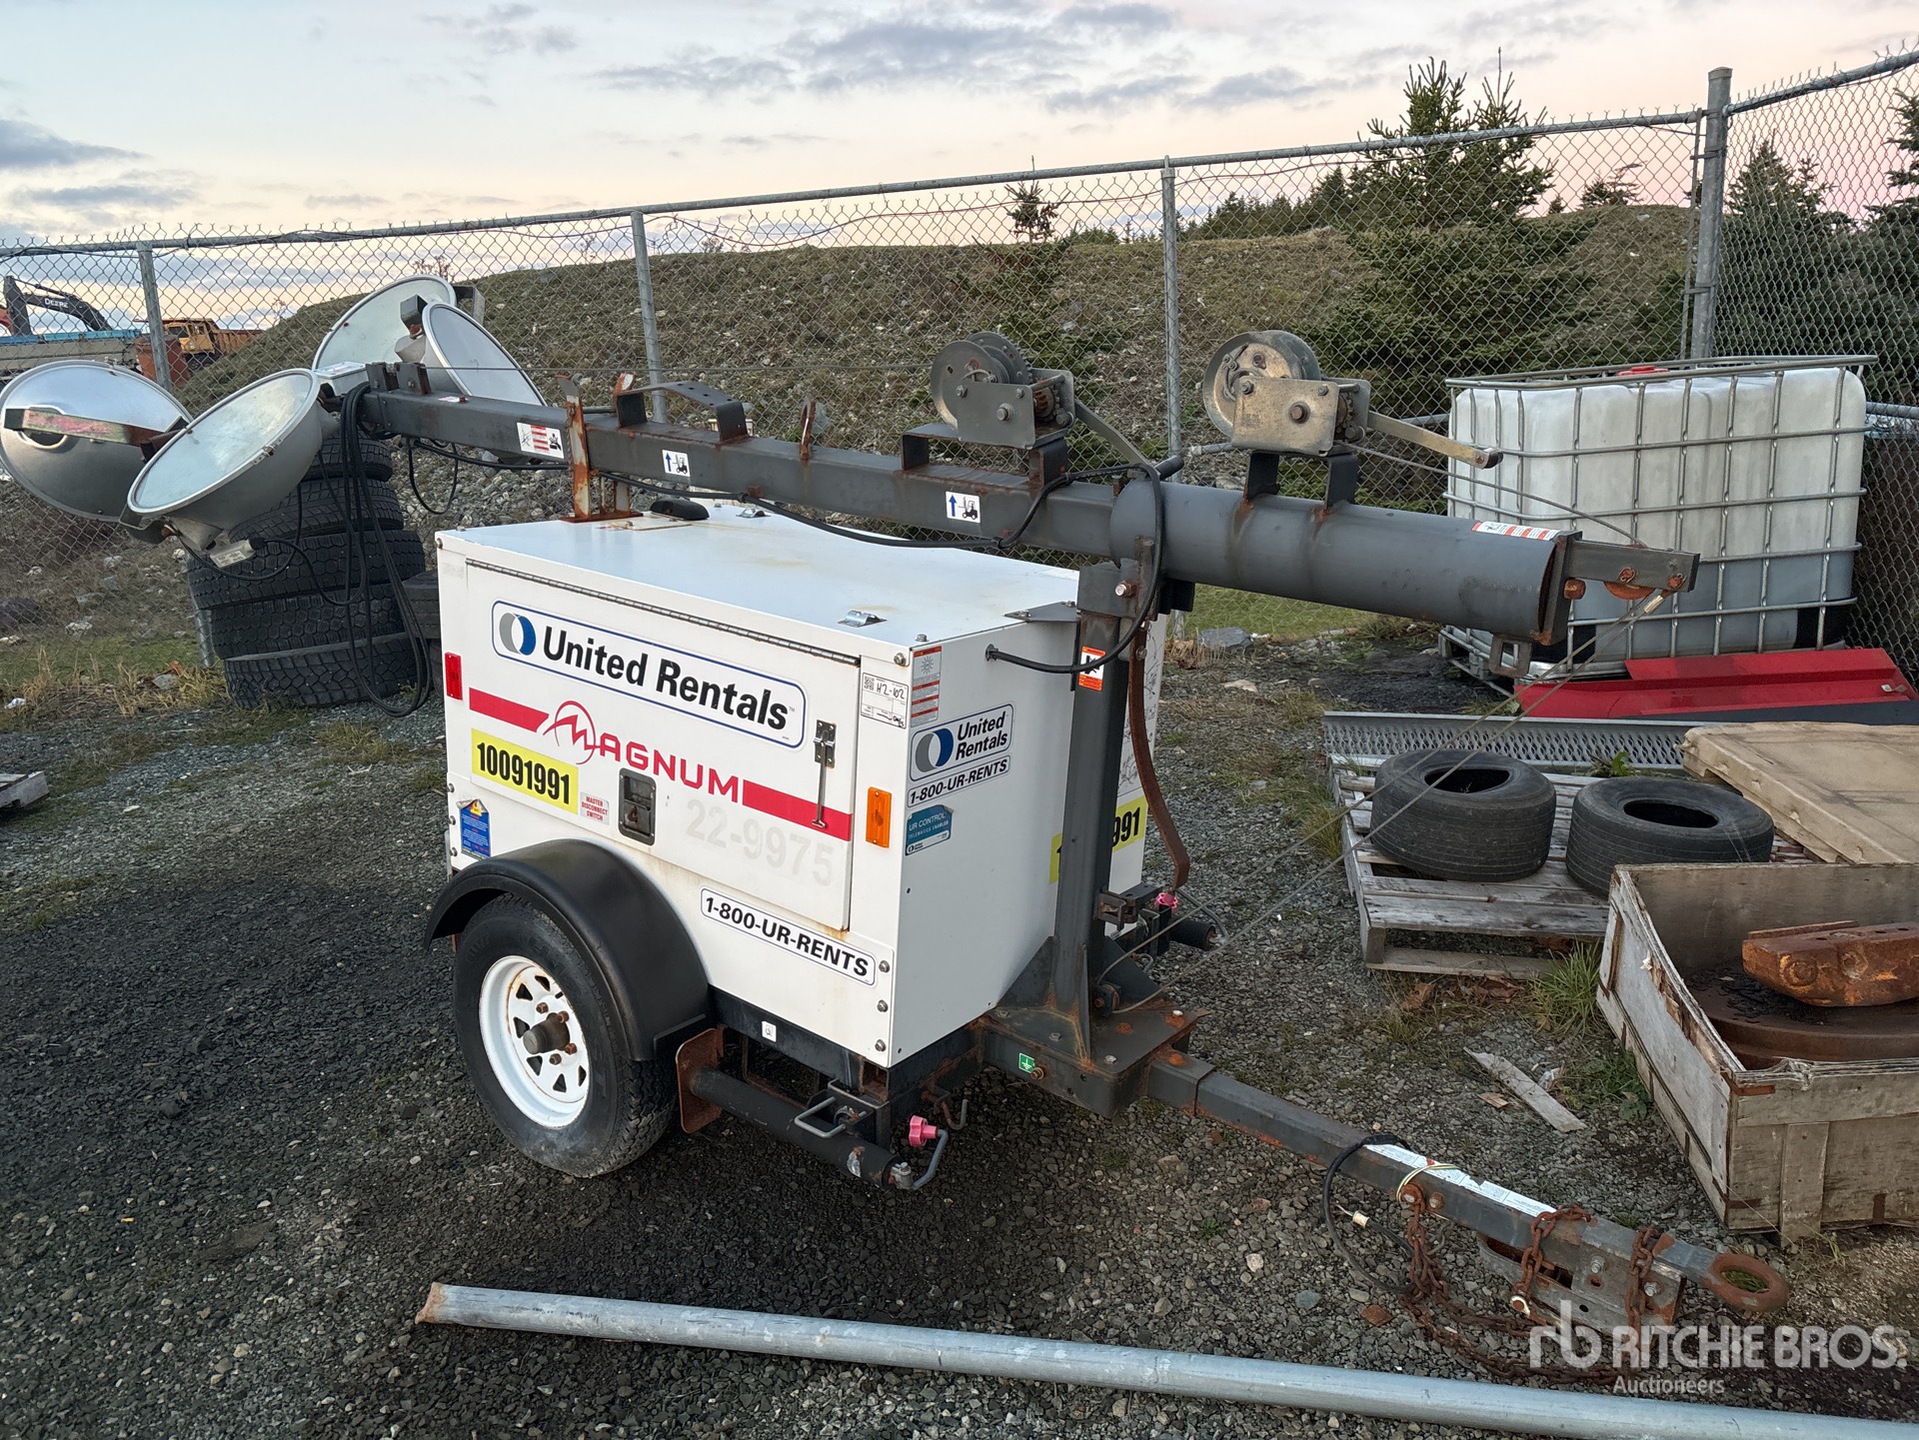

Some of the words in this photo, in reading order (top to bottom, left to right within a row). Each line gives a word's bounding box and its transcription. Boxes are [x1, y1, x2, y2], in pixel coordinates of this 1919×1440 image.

[44, 297, 68, 308] DEERE
[543, 625, 648, 687] United
[655, 658, 789, 731] Rentals
[955, 730, 1008, 761] Rentals
[957, 711, 1006, 741] United
[476, 742, 571, 805] 10091991
[543, 701, 739, 803] MAGNUM
[586, 796, 603, 806] MASTER
[910, 759, 1007, 804] 1-800-UR-RENTS
[686, 798, 835, 887] 22-9975
[908, 822, 918, 832] UR
[918, 812, 946, 828] CONTROL
[706, 897, 868, 978] 1-800-UR-RENTS
